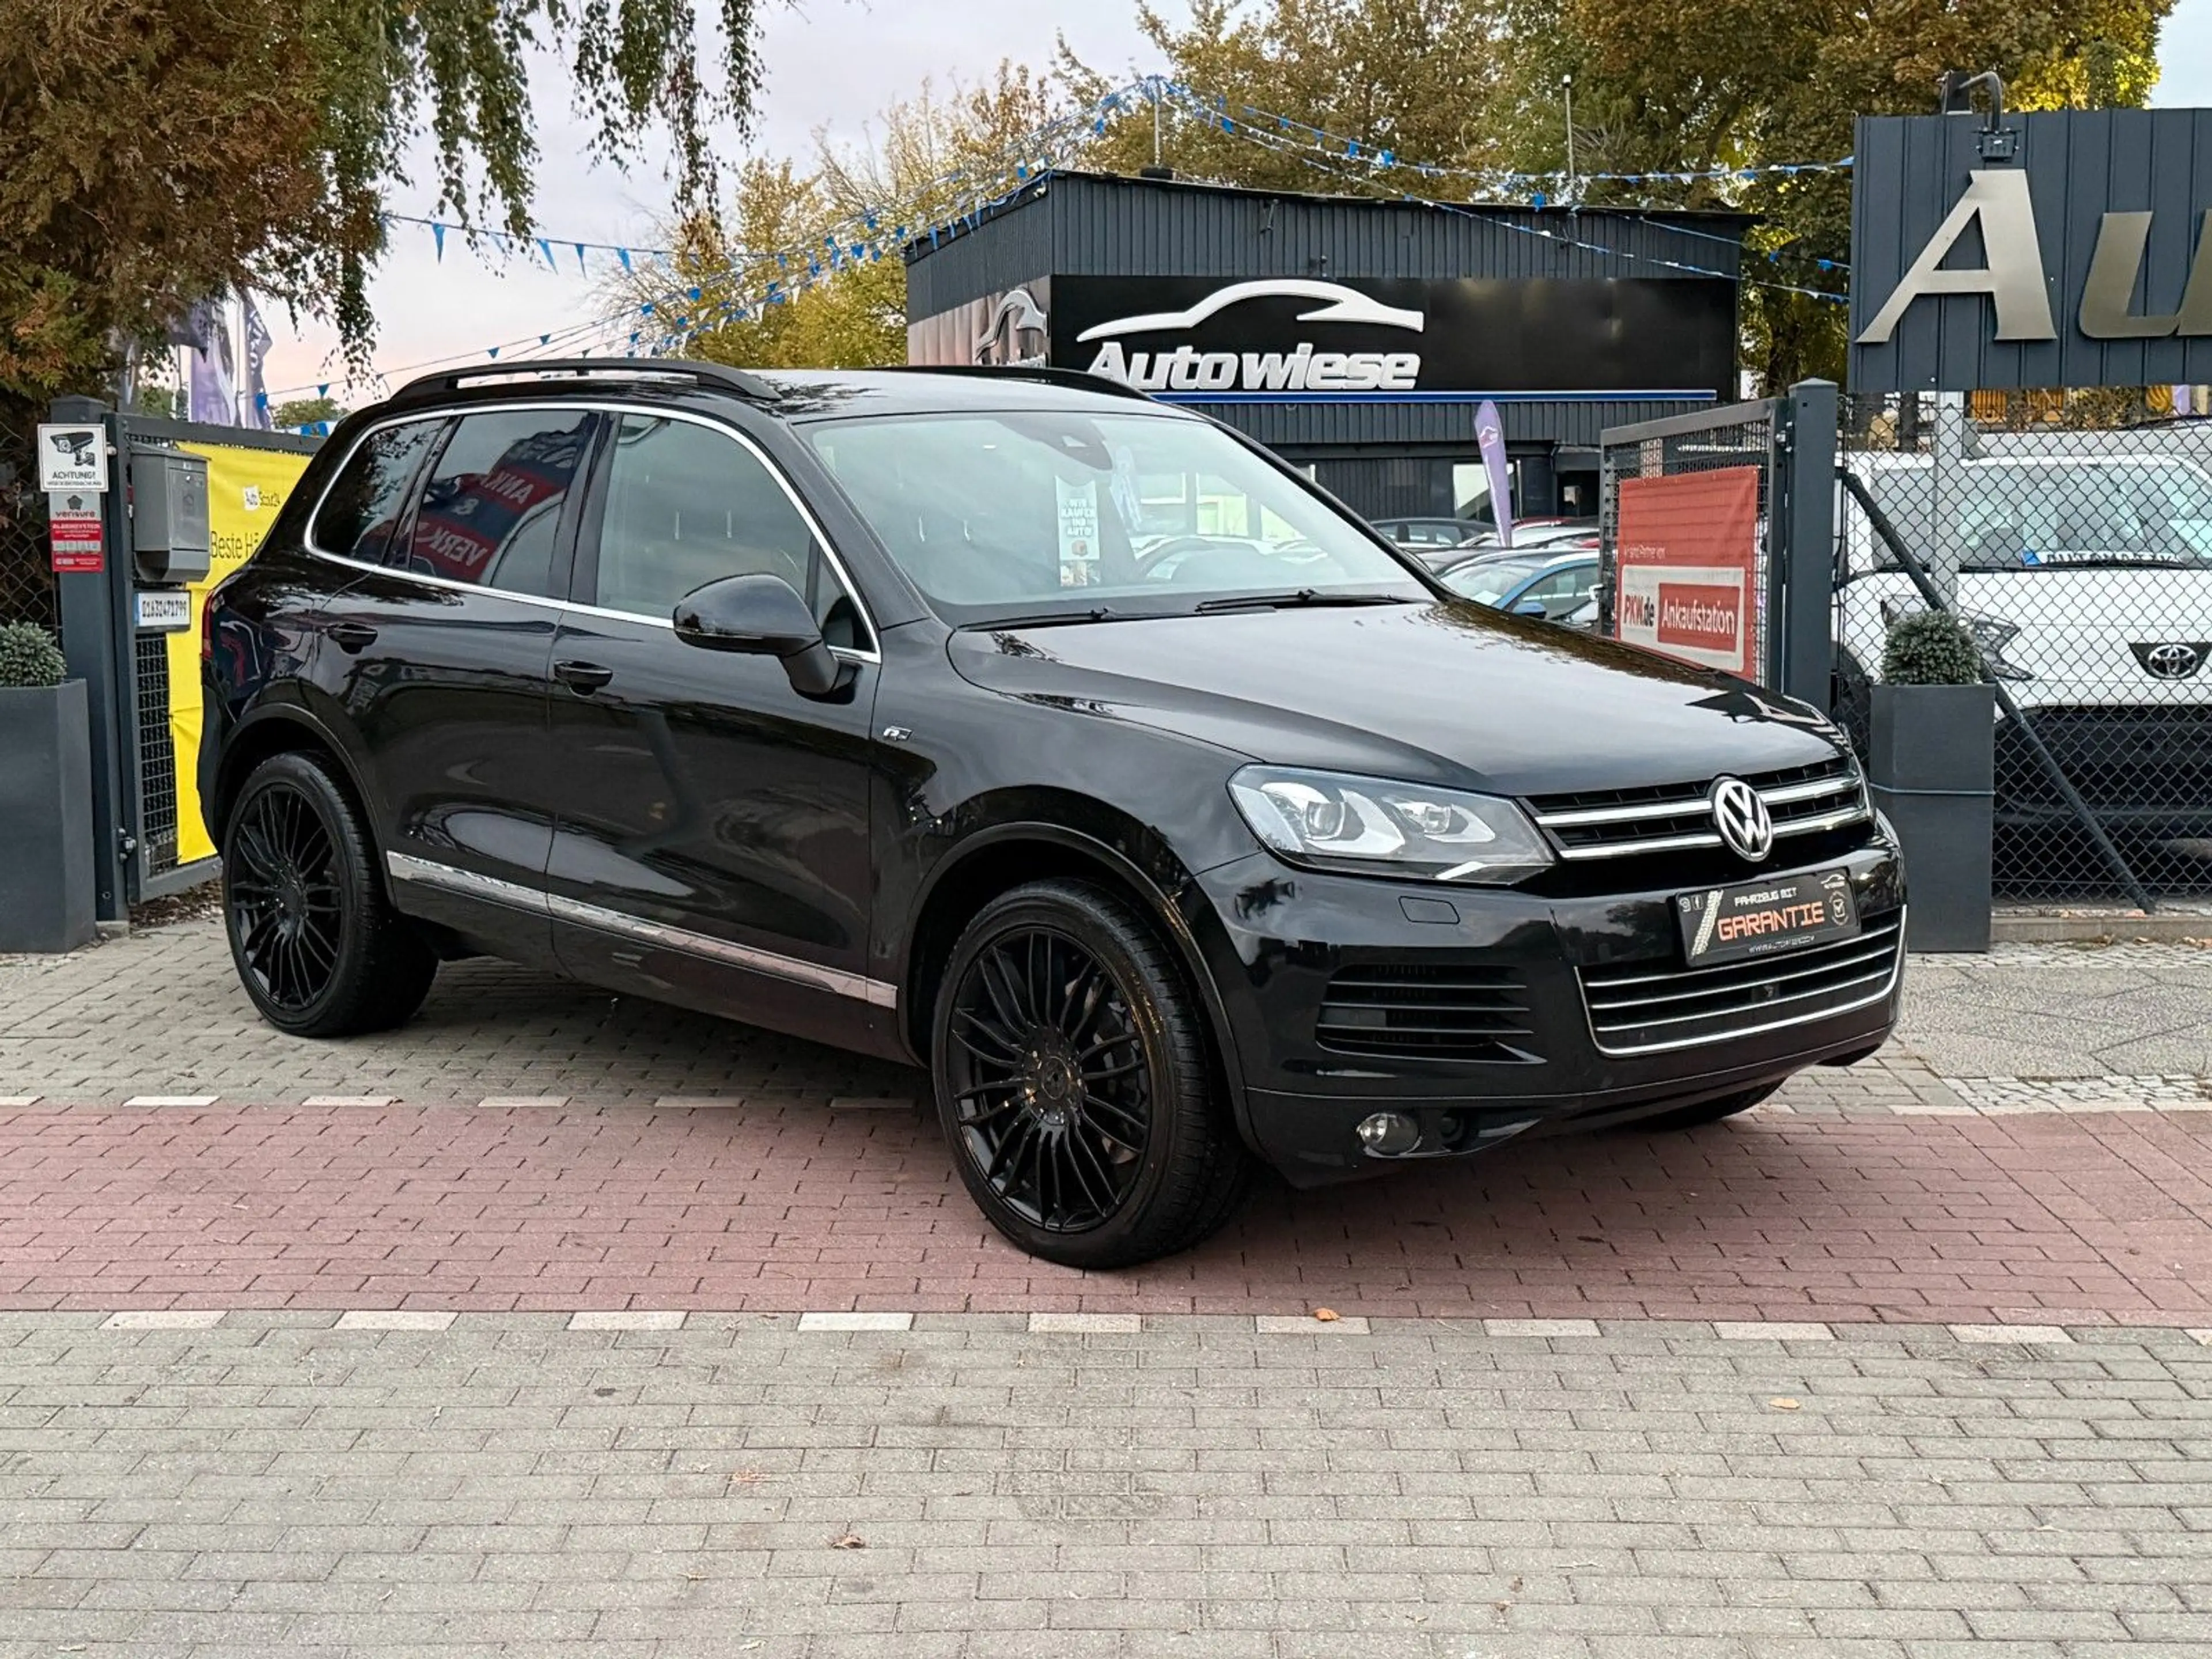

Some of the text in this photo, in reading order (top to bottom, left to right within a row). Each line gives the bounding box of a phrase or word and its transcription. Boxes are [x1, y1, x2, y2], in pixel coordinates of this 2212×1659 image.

[1086, 342, 1421, 390] Autowiese
[52, 471, 97, 479] ACHTUNG!
[210, 531, 243, 559] Beste
[1624, 594, 1735, 634] PKW.de Ankaufstation
[1717, 900, 1825, 941] GARANTIE
